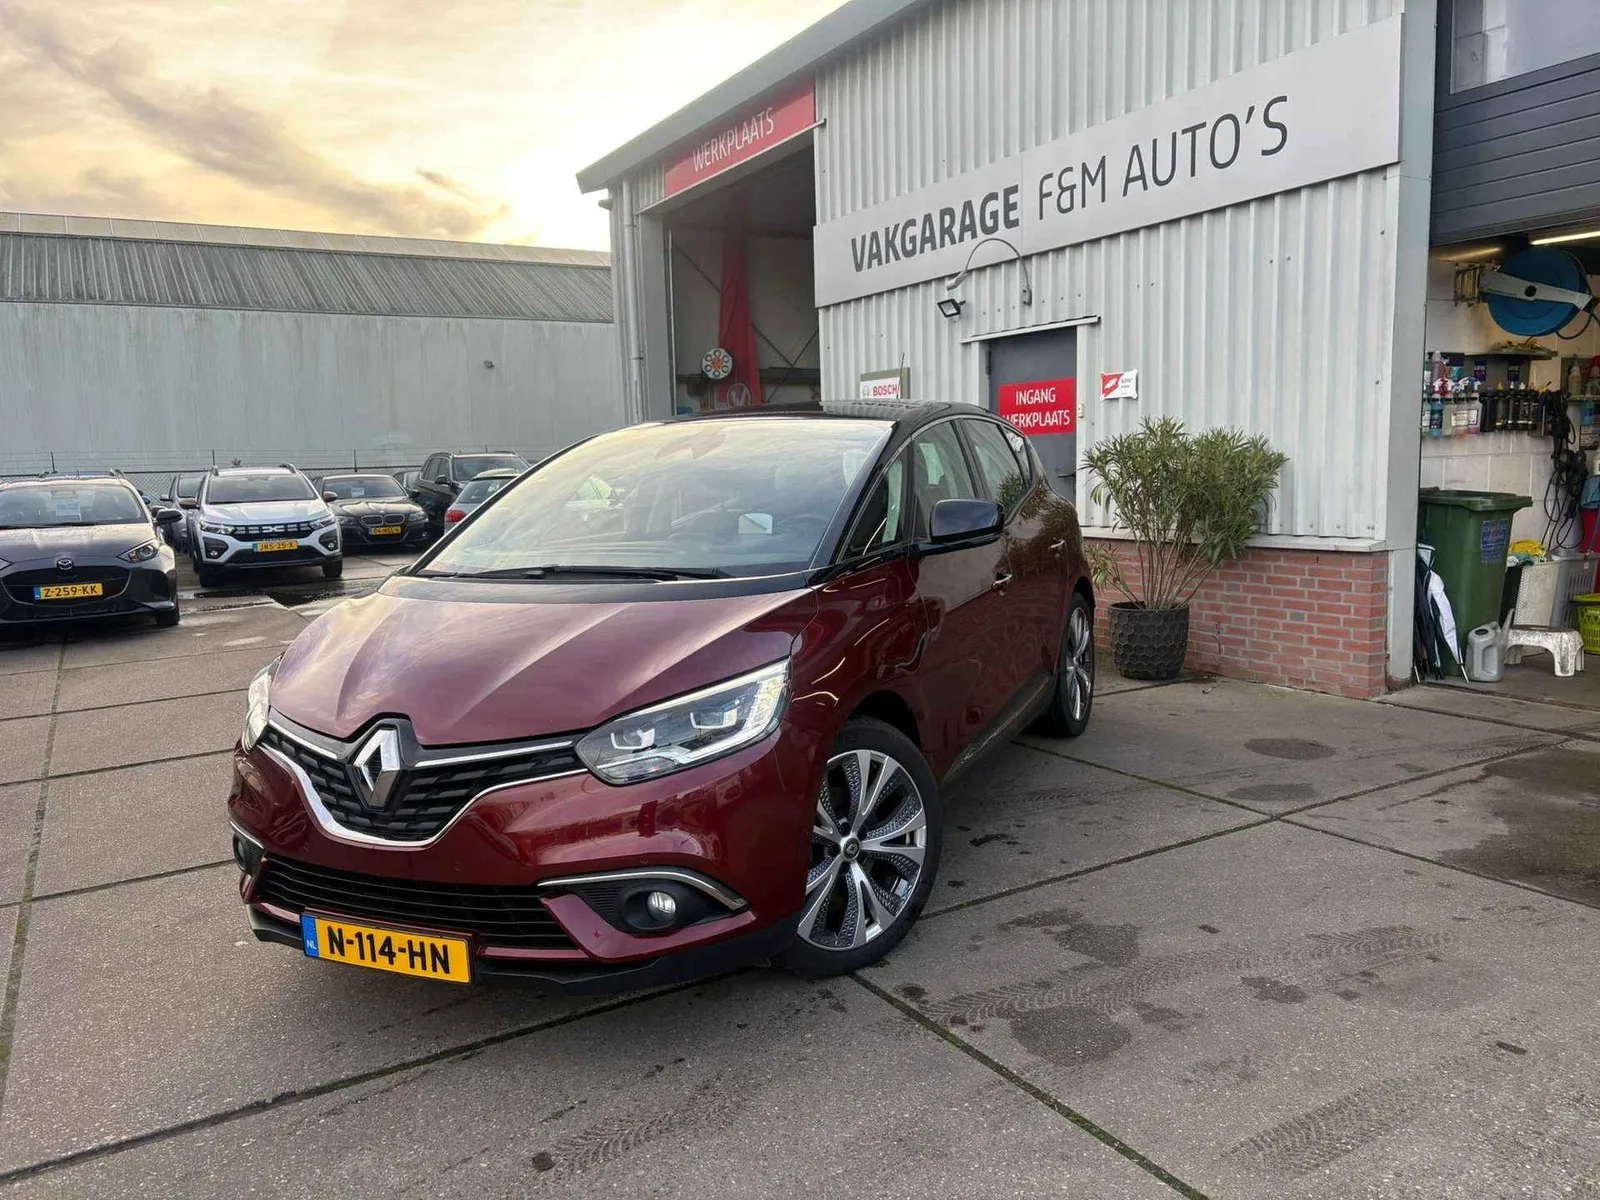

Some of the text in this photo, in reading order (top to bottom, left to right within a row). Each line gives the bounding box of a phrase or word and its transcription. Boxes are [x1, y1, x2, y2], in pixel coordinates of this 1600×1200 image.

[692, 107, 775, 172] WERKPLAATS
[850, 95, 1288, 273] VAKGARAGE F&M AUTO'S
[872, 383, 899, 397] BOSCH
[1015, 387, 1056, 406] INGANG
[44, 585, 98, 598] Z-259-KK
[306, 926, 450, 974] NL N-114-HN
